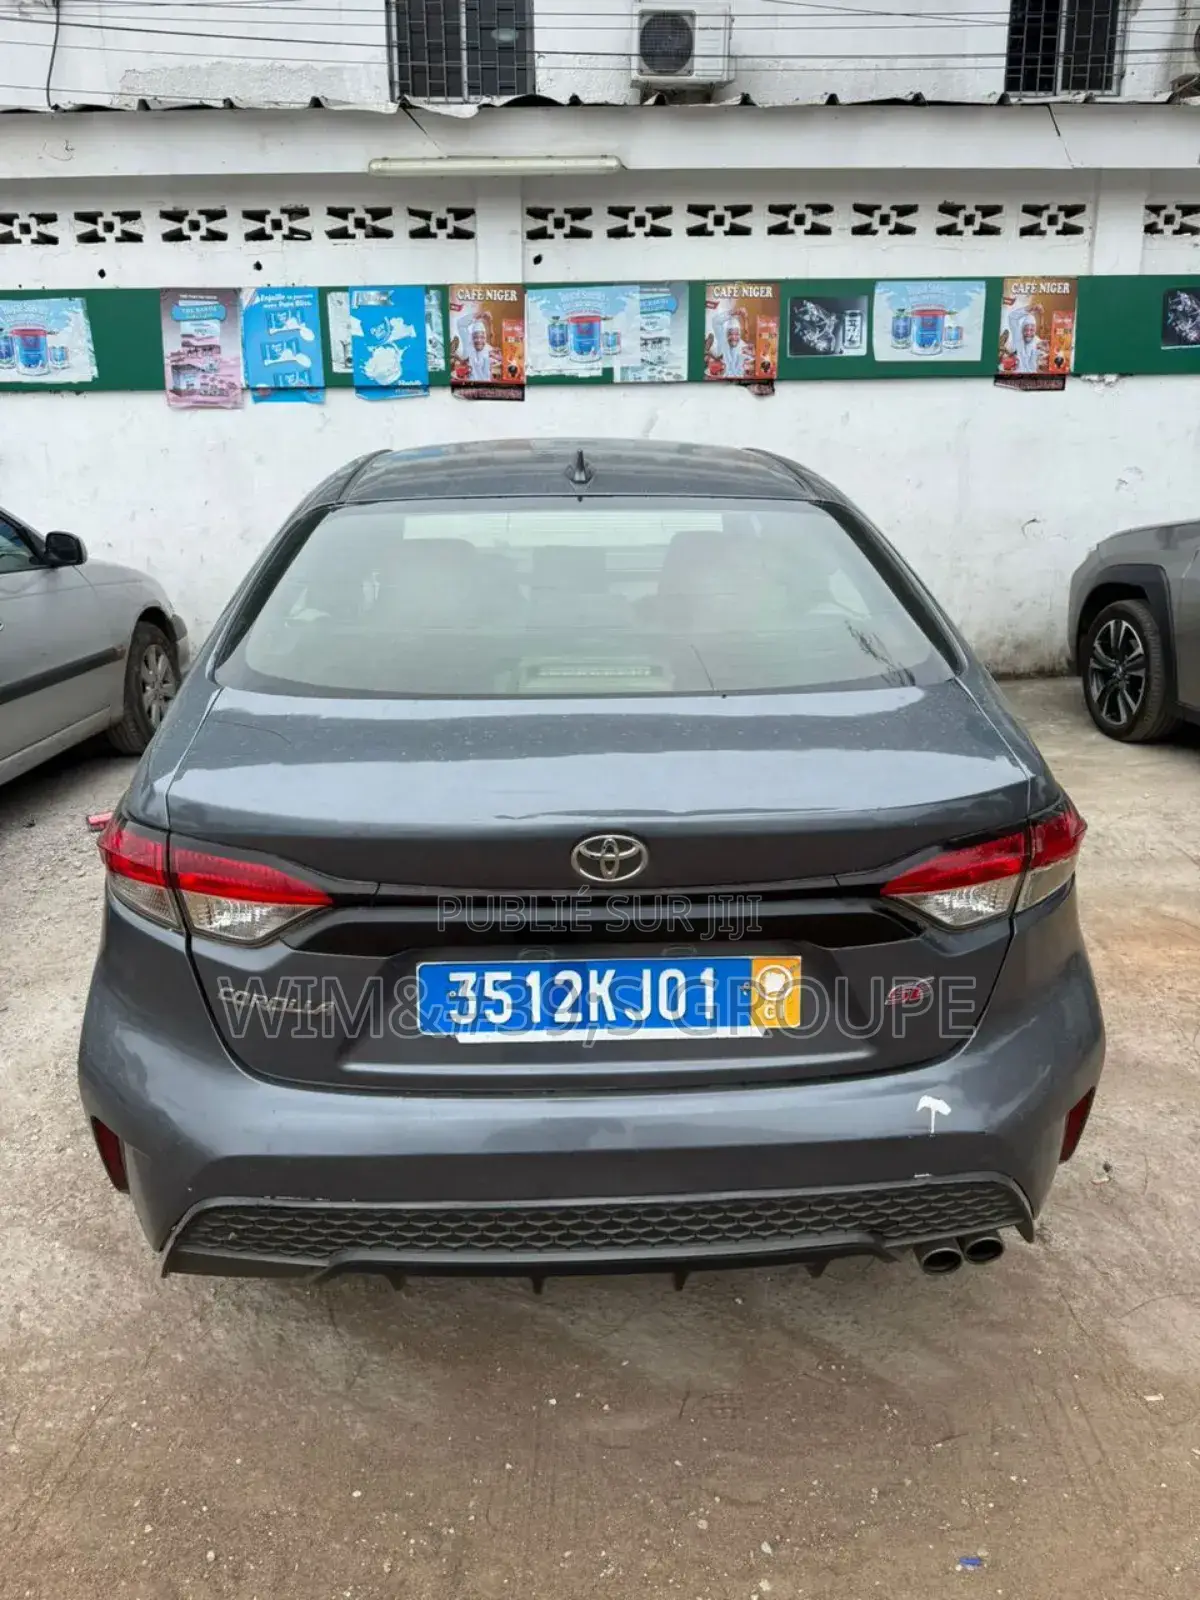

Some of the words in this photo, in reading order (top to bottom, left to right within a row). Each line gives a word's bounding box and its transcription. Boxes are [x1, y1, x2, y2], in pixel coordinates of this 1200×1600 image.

[741, 286, 773, 298] NIGER
[1040, 282, 1070, 294] NIGER
[485, 289, 518, 301] NIGER
[449, 966, 716, 1024] 3512KJ01
